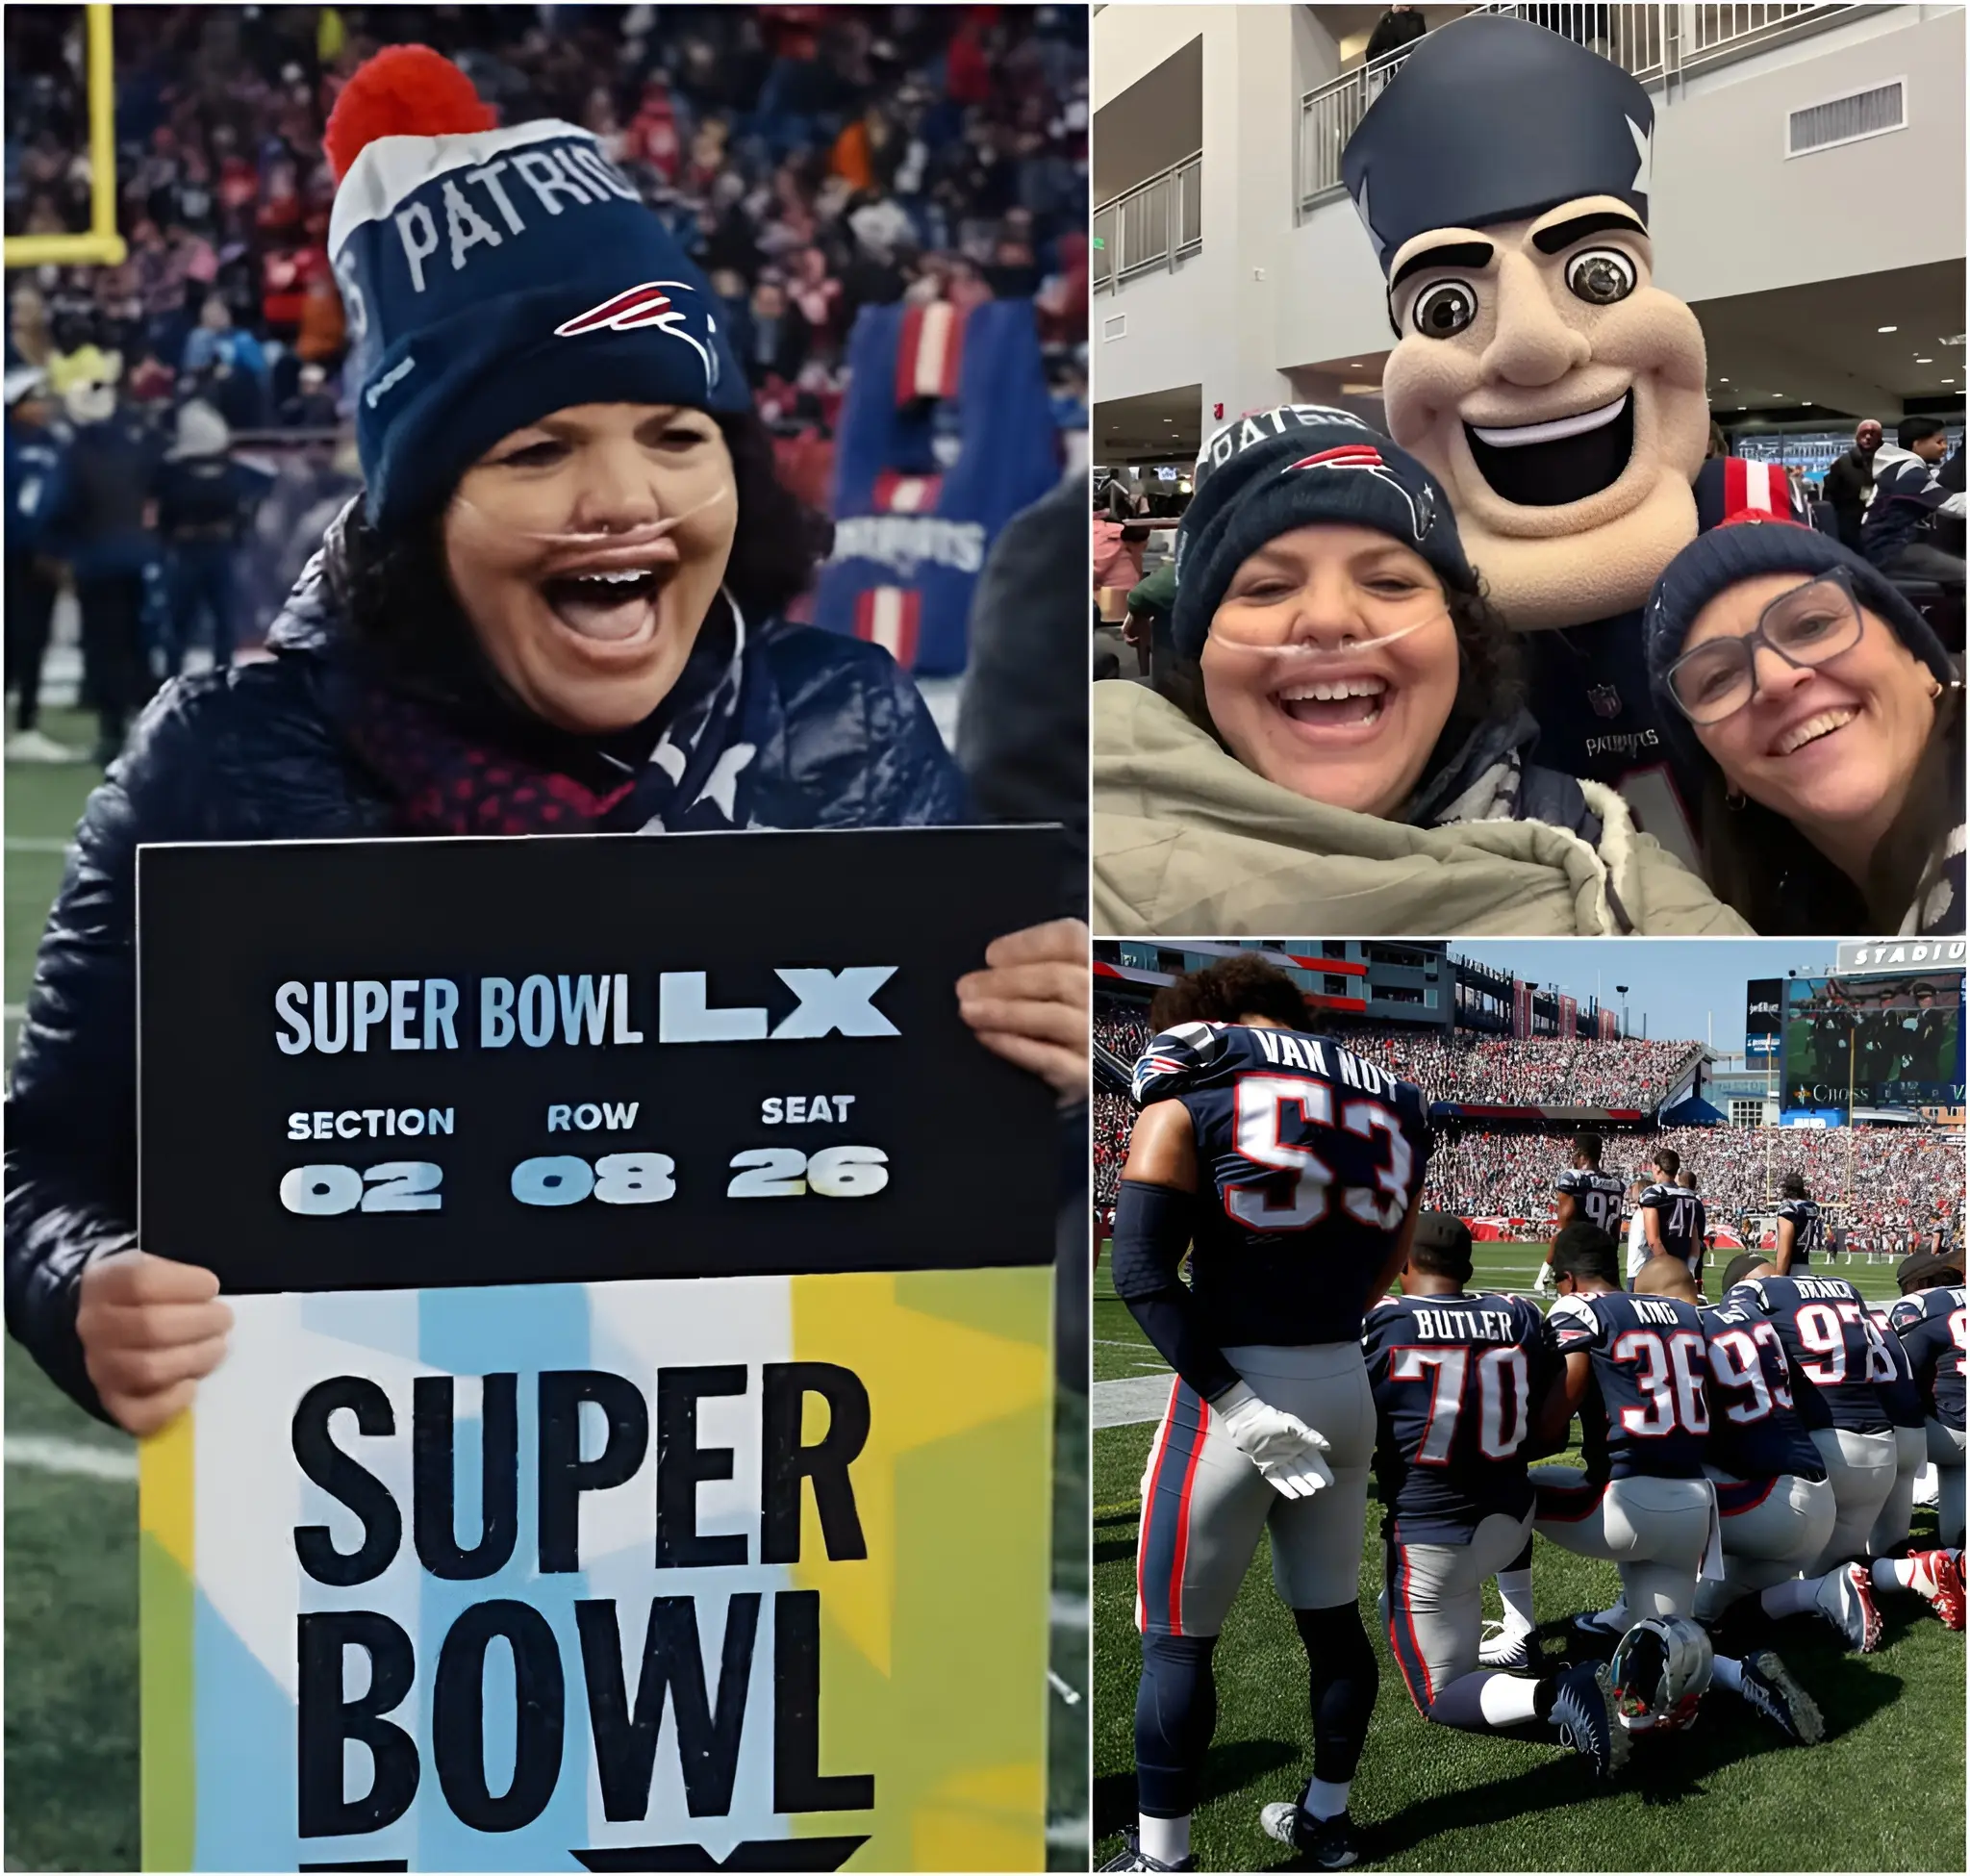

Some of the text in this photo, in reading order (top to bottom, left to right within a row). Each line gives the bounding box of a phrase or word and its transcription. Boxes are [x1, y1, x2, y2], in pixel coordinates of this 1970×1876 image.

[1854, 942, 1966, 966] STADIU
[276, 966, 902, 1055] SUPER BOWL LX
[1250, 1028, 1398, 1103] VAN NOY
[288, 1095, 856, 1140] SECTION ROW SEAT
[1224, 1071, 1412, 1233] 53
[280, 1145, 890, 1216] 02 08 26
[1585, 1190, 1623, 1235] 92
[1667, 1198, 1697, 1238] 47
[1412, 1309, 1514, 1342] BUTLER
[1629, 1299, 1680, 1325] KING
[1389, 1344, 1529, 1467] 70
[1611, 1329, 1710, 1440] 36
[1708, 1320, 1794, 1424] 93
[291, 1362, 872, 1587] SUPER
[296, 1589, 875, 1838] BOWL
